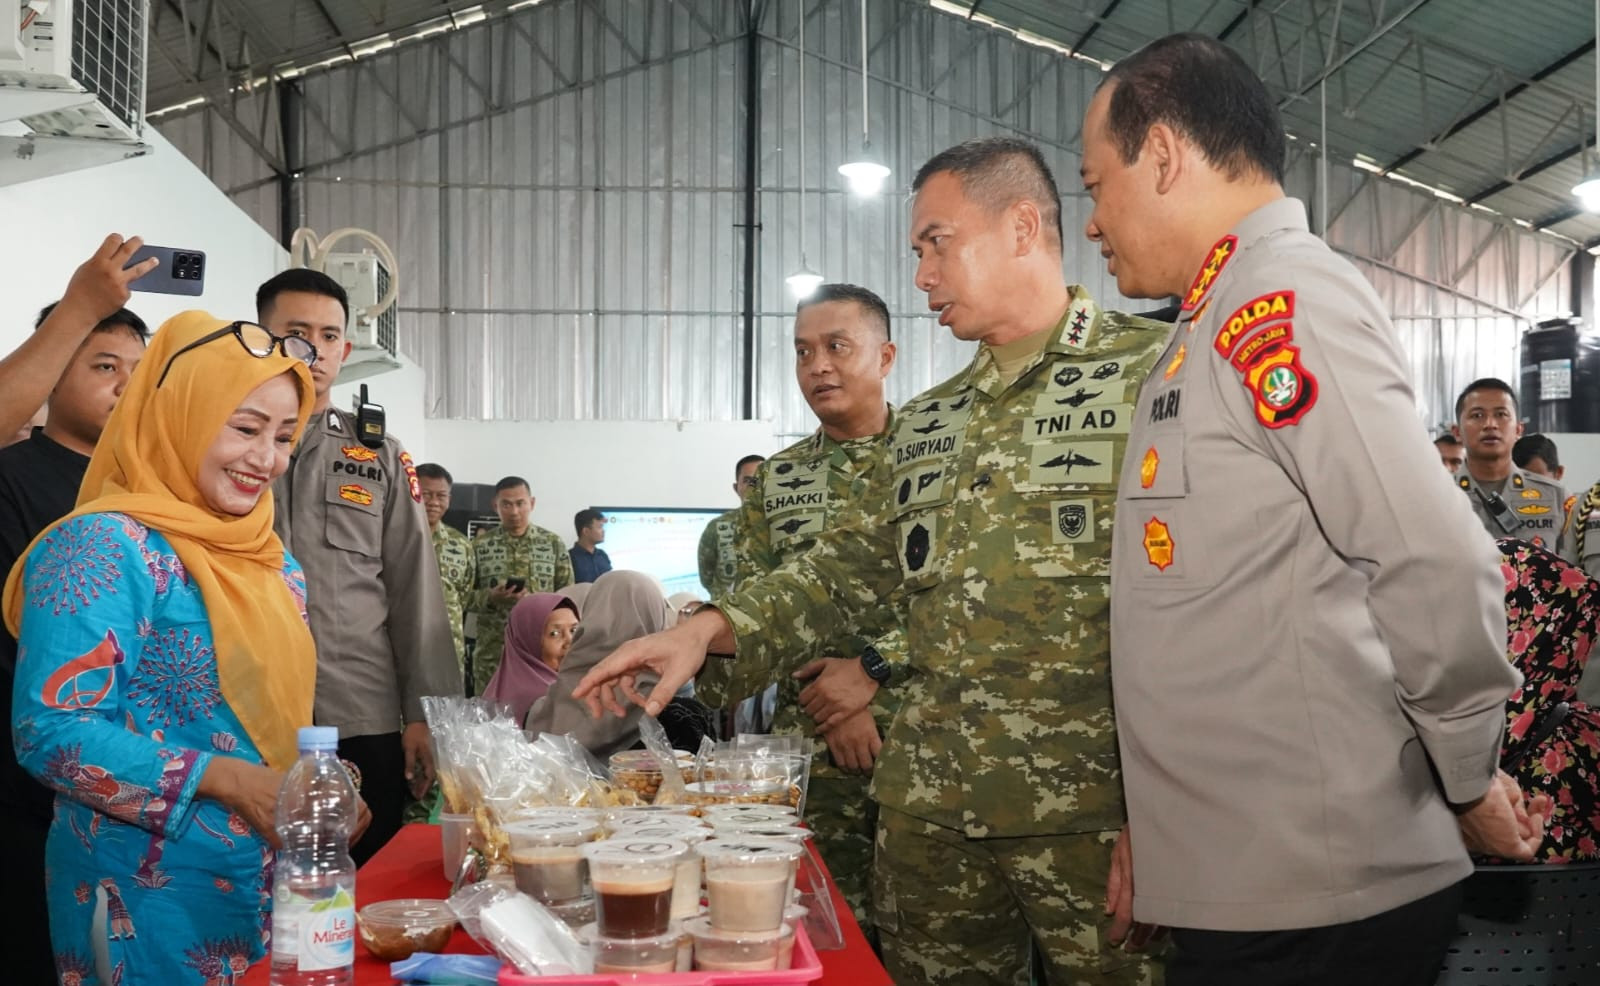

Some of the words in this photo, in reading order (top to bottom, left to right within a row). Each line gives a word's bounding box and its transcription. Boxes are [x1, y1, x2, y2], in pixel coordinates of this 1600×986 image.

[1219, 296, 1287, 348] POLDA
[1035, 414, 1071, 435] TNI
[1081, 409, 1116, 429] AD
[896, 434, 956, 465] D.SURYADI
[333, 460, 382, 482] POLRI
[765, 492, 823, 513] S.HAKKI
[1519, 518, 1553, 529] POLRI
[333, 917, 346, 930] Le
[313, 929, 354, 944] Minera
